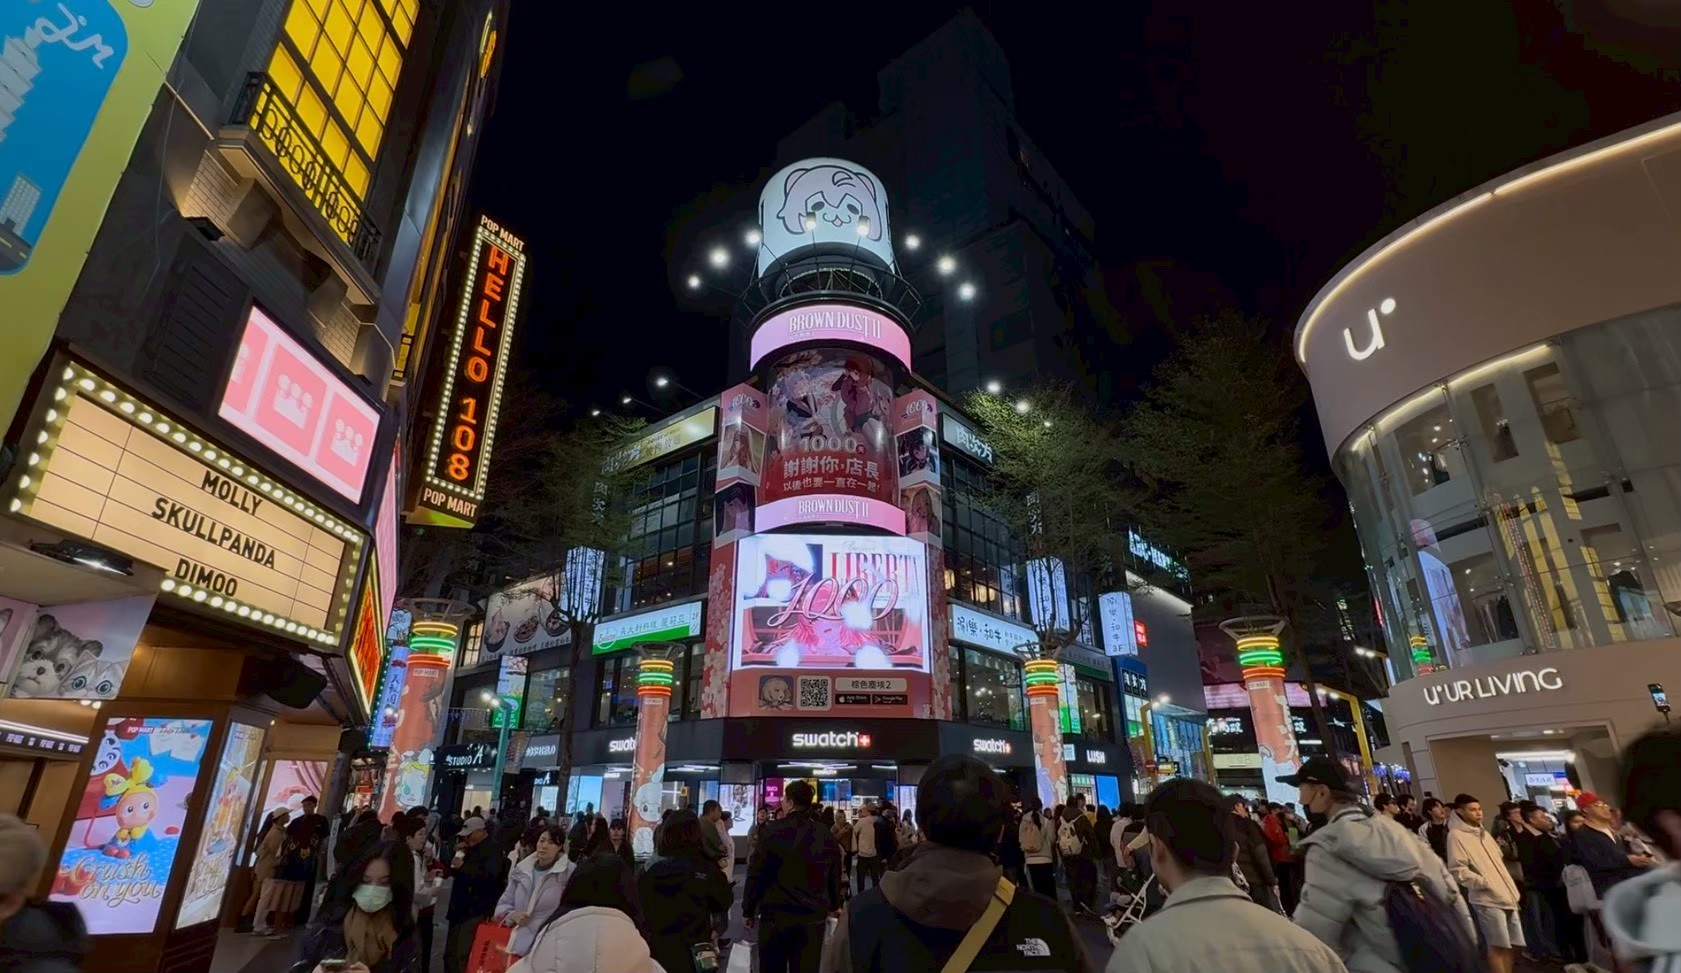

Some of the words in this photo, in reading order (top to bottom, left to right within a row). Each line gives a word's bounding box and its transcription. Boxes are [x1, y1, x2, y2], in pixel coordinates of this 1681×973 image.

[481, 214, 499, 233] POP
[500, 228, 524, 251] MART
[468, 245, 509, 383] HELLO
[789, 311, 835, 333] BROWN
[837, 312, 869, 338] DUST
[872, 320, 880, 339] II
[448, 398, 477, 480] 108
[801, 436, 858, 453] 1000
[201, 470, 263, 516] MOLLY
[423, 487, 446, 506] POP
[447, 495, 477, 517] MART
[798, 500, 833, 514] BROWN
[835, 500, 860, 519] DUST
[151, 497, 276, 570] SKULLPANDA
[174, 558, 239, 597] DIMOO
[1475, 667, 1562, 698] LIVING
[792, 731, 859, 748] swatch
[973, 739, 1005, 754] swatch
[1086, 750, 1106, 764] LUSH
[75, 853, 150, 881] Crush
[80, 882, 109, 900] on
[107, 879, 162, 907] you
